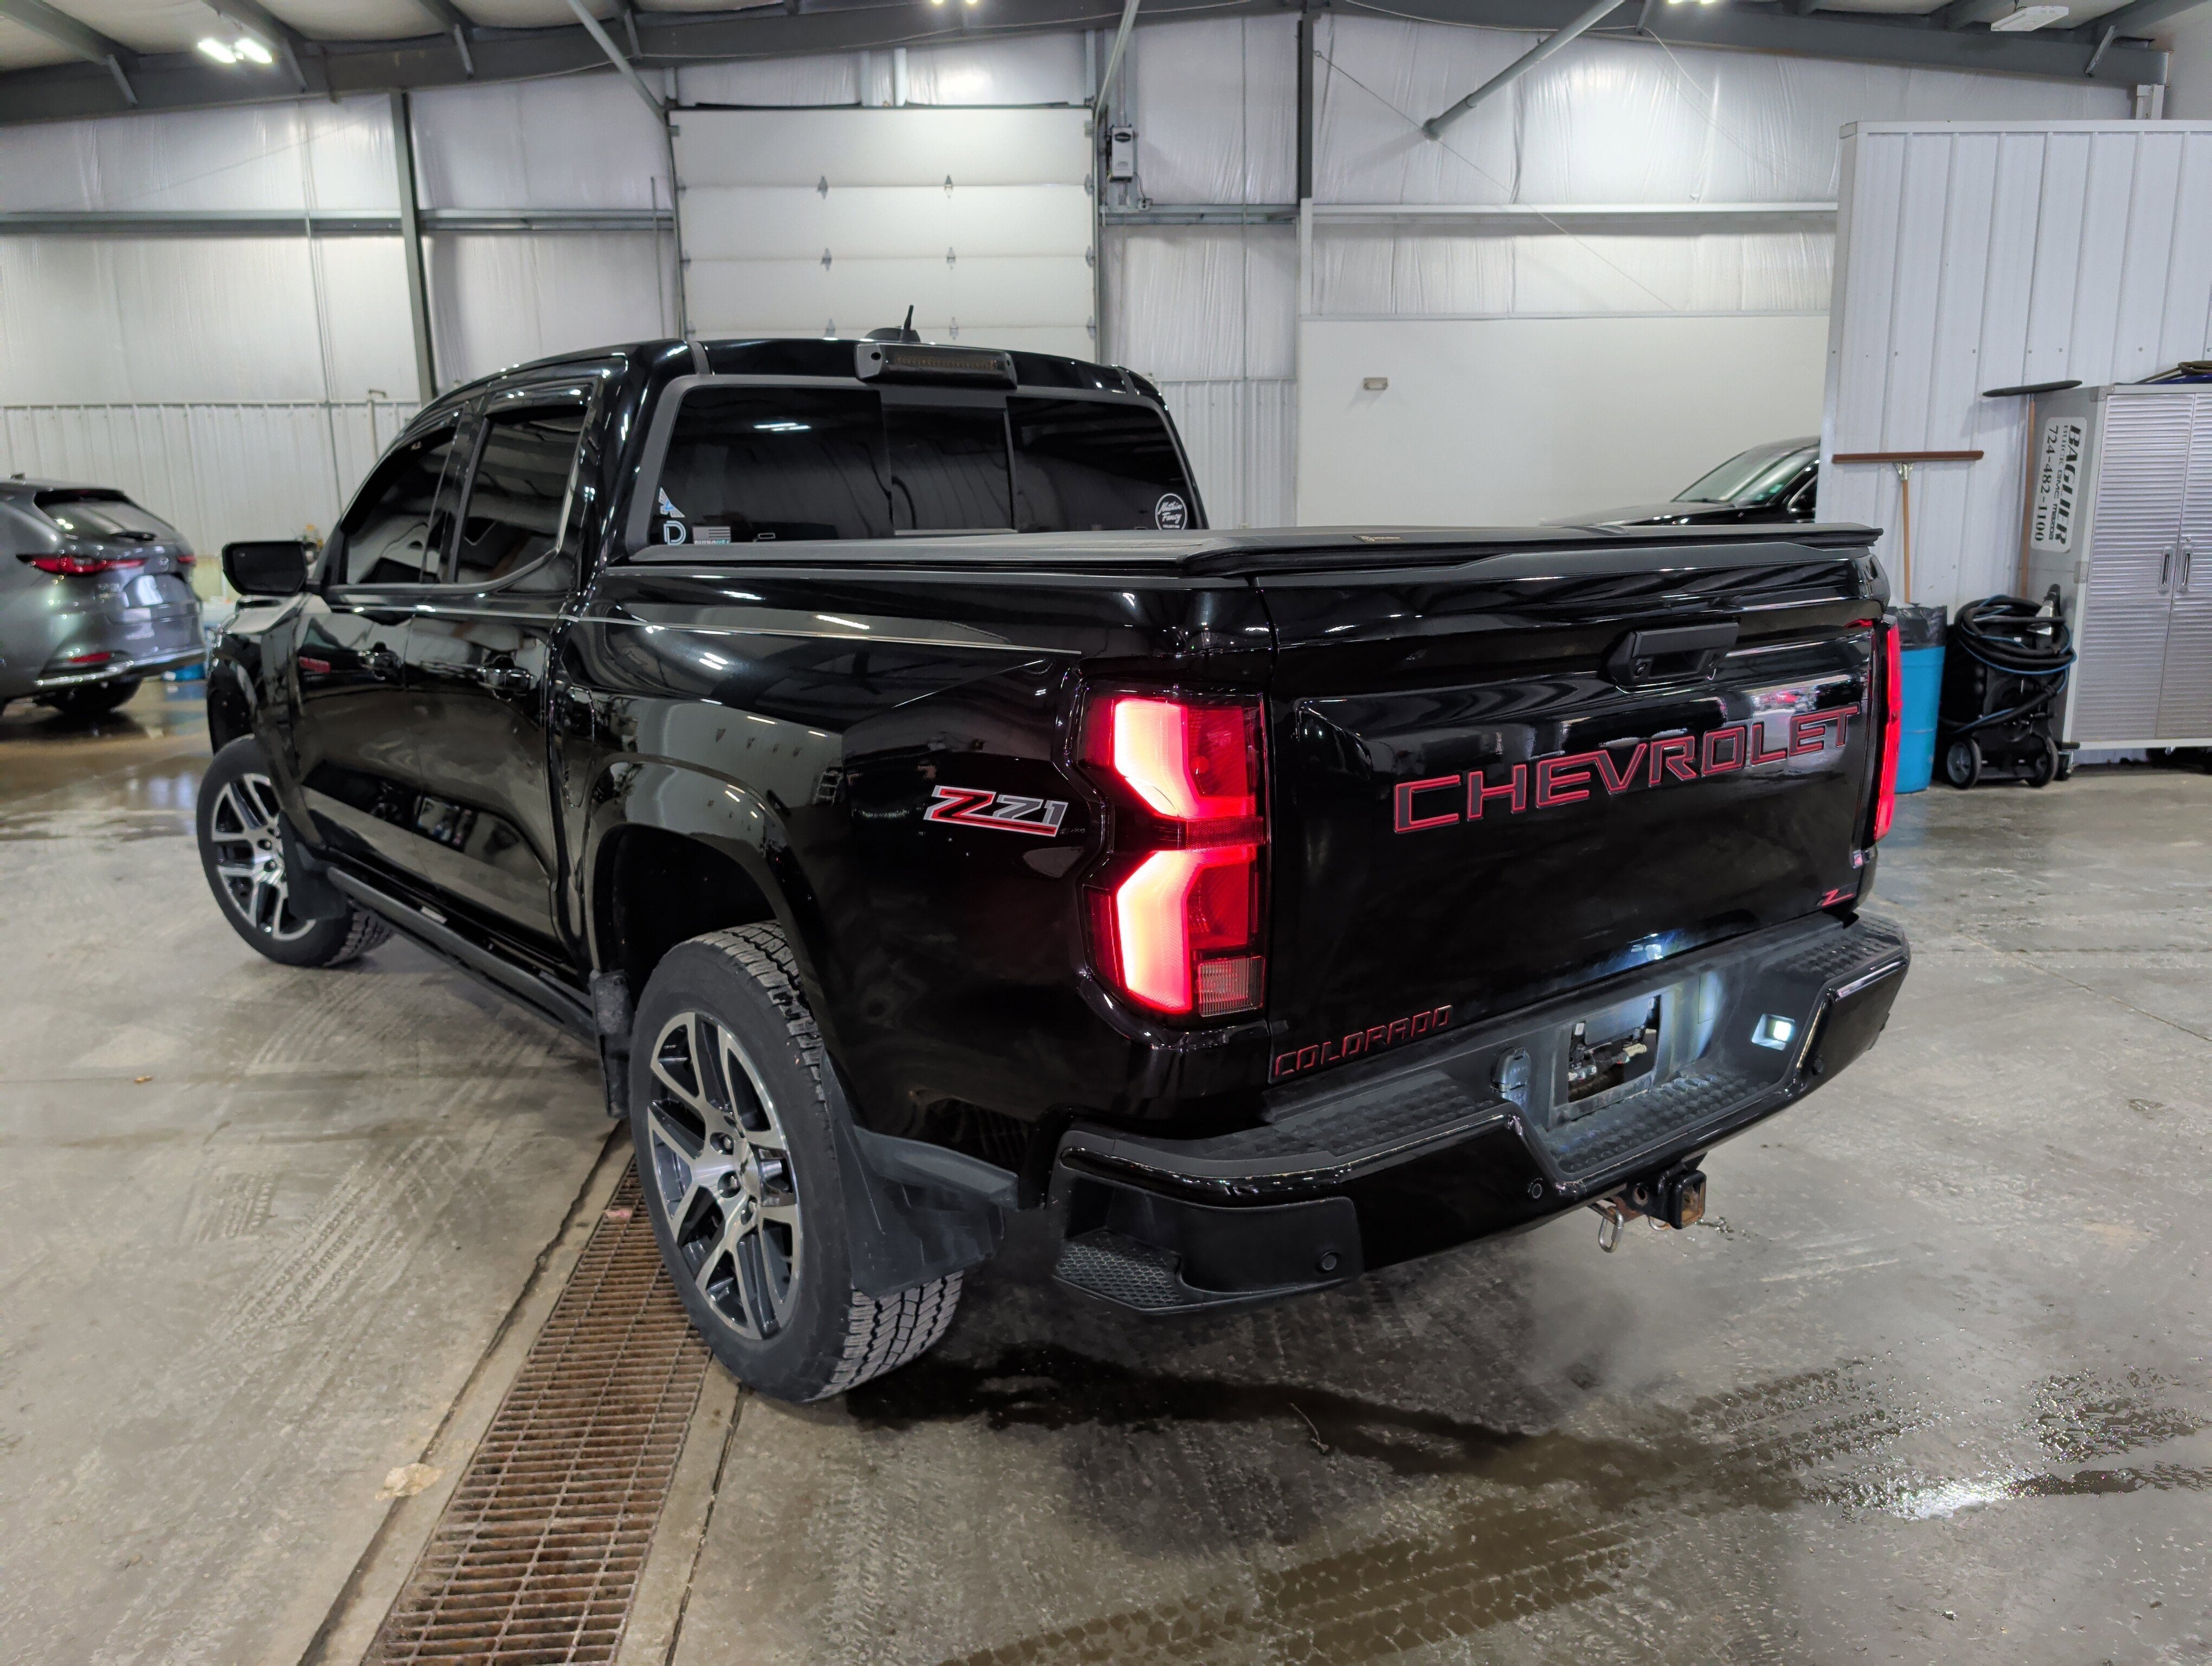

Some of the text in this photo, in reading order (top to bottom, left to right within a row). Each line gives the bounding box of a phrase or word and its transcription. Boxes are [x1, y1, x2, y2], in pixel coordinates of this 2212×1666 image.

[2034, 425, 2059, 541] 724-482-1100
[2054, 469, 2063, 500] GMC
[2055, 425, 2081, 544] BAGLIER
[923, 785, 1069, 837] Z71
[1394, 704, 1860, 834] CHEVROLET
[1275, 1004, 1454, 1078] COLORADO
